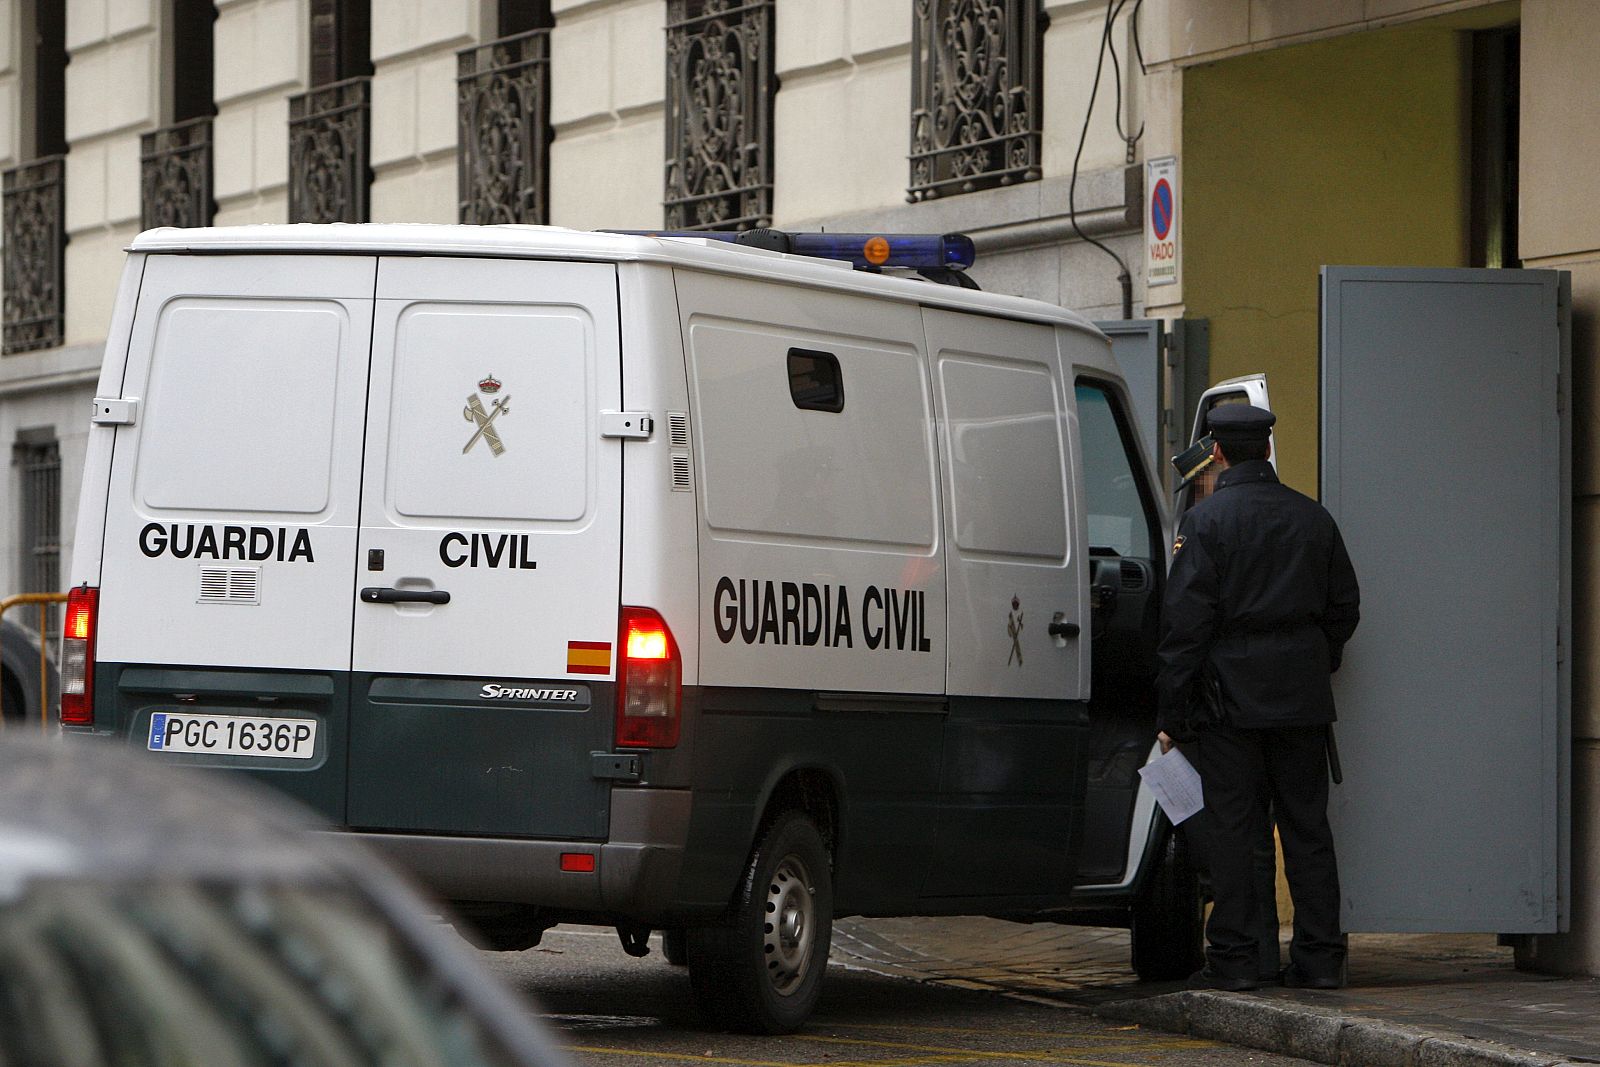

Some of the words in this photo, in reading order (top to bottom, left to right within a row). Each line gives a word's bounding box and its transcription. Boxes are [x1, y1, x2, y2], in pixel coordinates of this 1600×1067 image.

[1150, 242, 1174, 260] VADO
[139, 523, 314, 562] GUARDIA
[439, 532, 536, 570] CIVIL
[713, 576, 853, 649] GUARDIA
[862, 585, 931, 653] CIVIL
[479, 683, 578, 702] SPRINTER
[153, 734, 161, 743] E
[164, 718, 218, 748] PGC
[227, 721, 311, 753] 1636P
